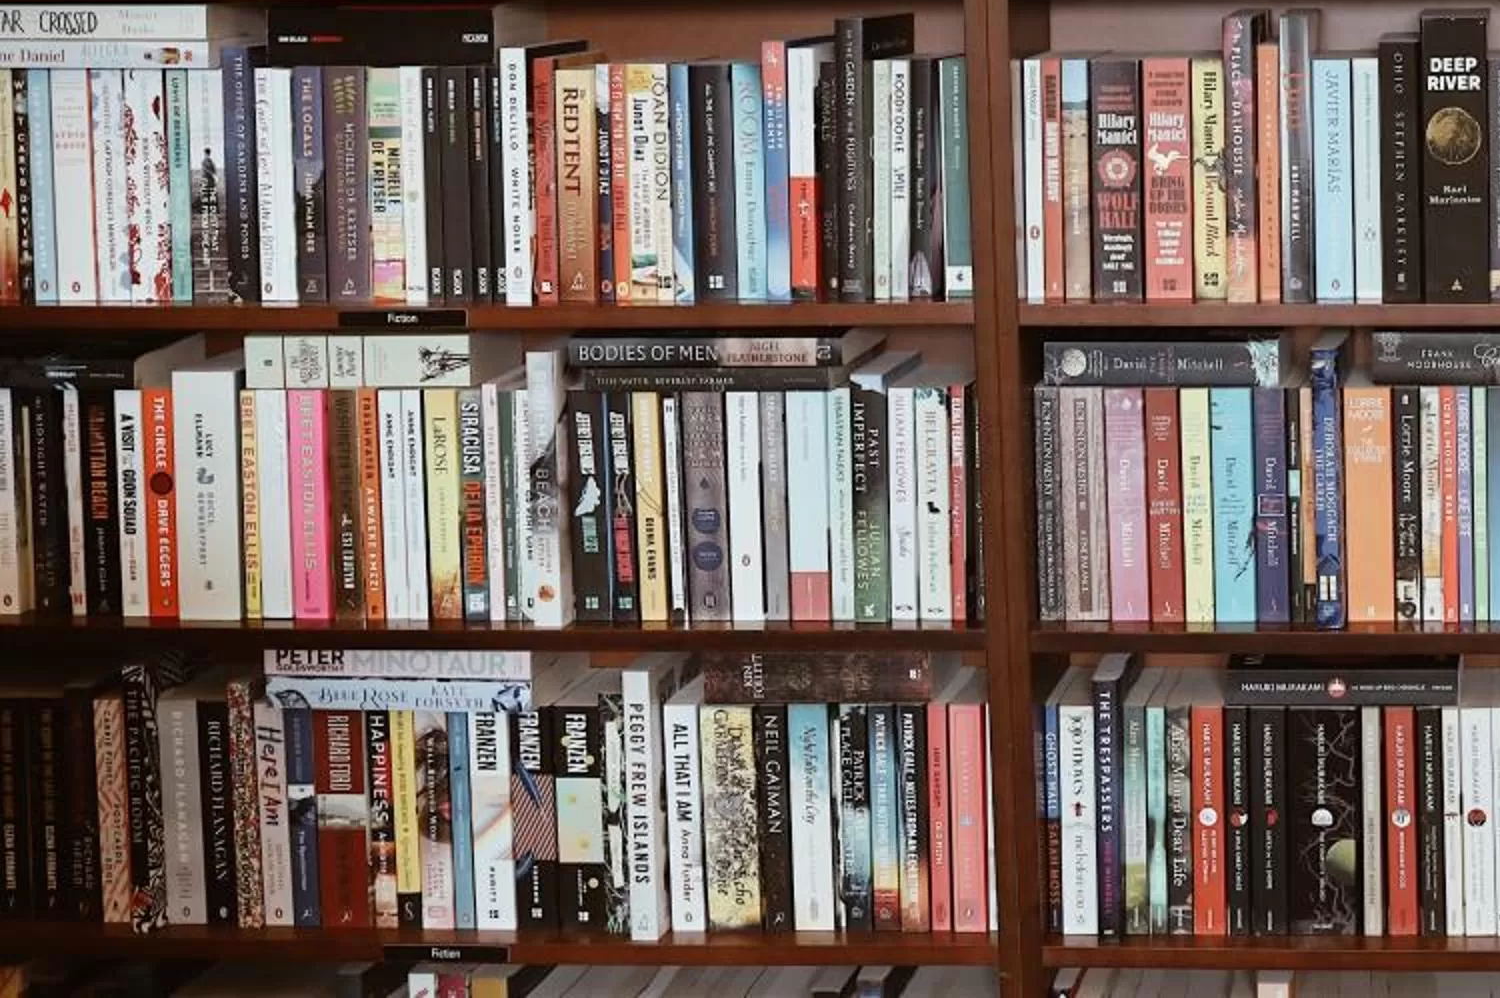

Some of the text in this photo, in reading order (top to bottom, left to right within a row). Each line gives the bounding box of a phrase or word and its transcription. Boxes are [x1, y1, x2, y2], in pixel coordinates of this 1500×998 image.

[39, 12, 97, 35] CROSSED
[20, 50, 64, 62] Daniel
[1430, 58, 1477, 72] DEEP
[1427, 75, 1480, 90] RIVER
[1098, 114, 1135, 129] Hilary
[563, 88, 581, 197] RED TENT
[652, 74, 668, 201] JOAN DIDION
[1098, 129, 1136, 144] Mantel
[387, 313, 417, 324] Fiction
[578, 344, 717, 361] BODIES OF MEN
[1177, 357, 1223, 371] Mitchell
[153, 396, 164, 419] THE
[462, 402, 480, 475] SIRACUSA
[854, 402, 865, 493] IMPERFECT
[869, 427, 879, 467] PAST
[156, 499, 168, 532] DAVE
[276, 650, 344, 665] PETER
[352, 656, 506, 675] MINOTAUR
[475, 712, 496, 772] FRANZEN
[370, 715, 388, 822] HAPPINESS
[1100, 692, 1112, 832] THE TRESPASSERS
[763, 715, 781, 834] NEIL GAIMAN
[629, 704, 649, 885] PEGGY FREW ISLANDS
[431, 948, 461, 959] Fiction
